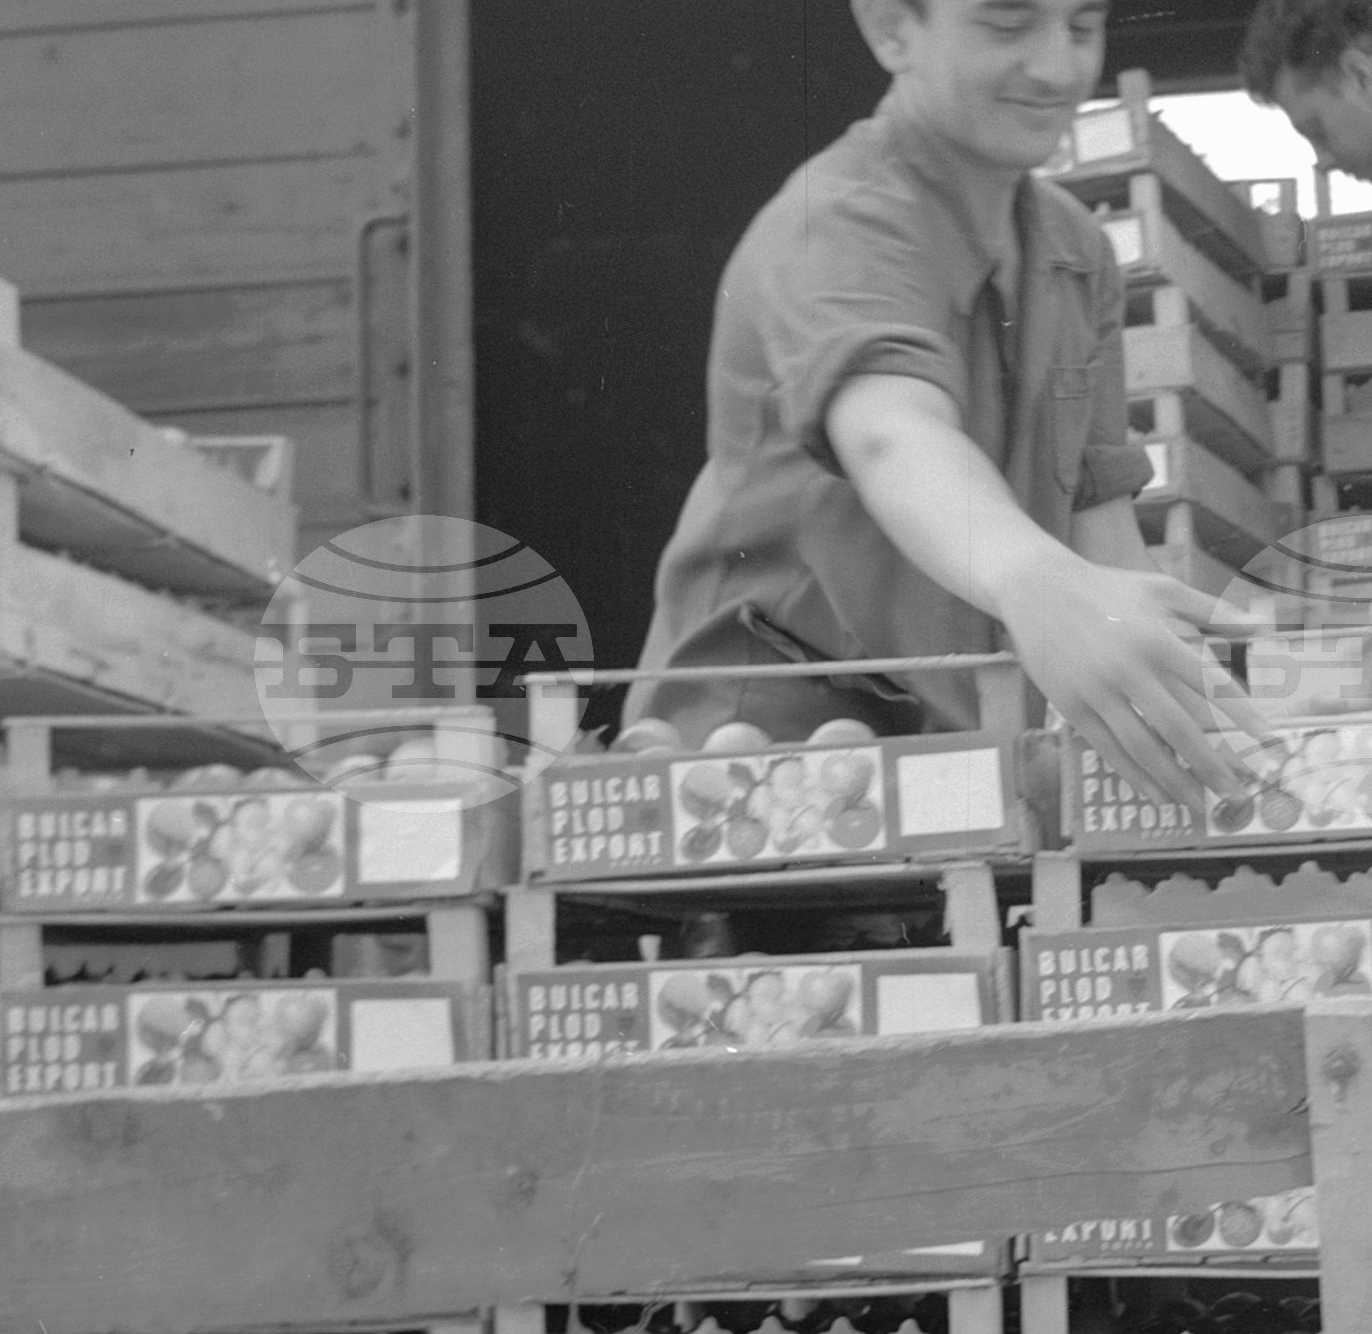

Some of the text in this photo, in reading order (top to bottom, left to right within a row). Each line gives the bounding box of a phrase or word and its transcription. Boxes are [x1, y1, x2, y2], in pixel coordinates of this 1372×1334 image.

[553, 805, 624, 835] PLOD
[554, 831, 662, 864] EXPORT
[1041, 975, 1112, 1005] PLOD
[529, 1012, 601, 1041] PLOD
